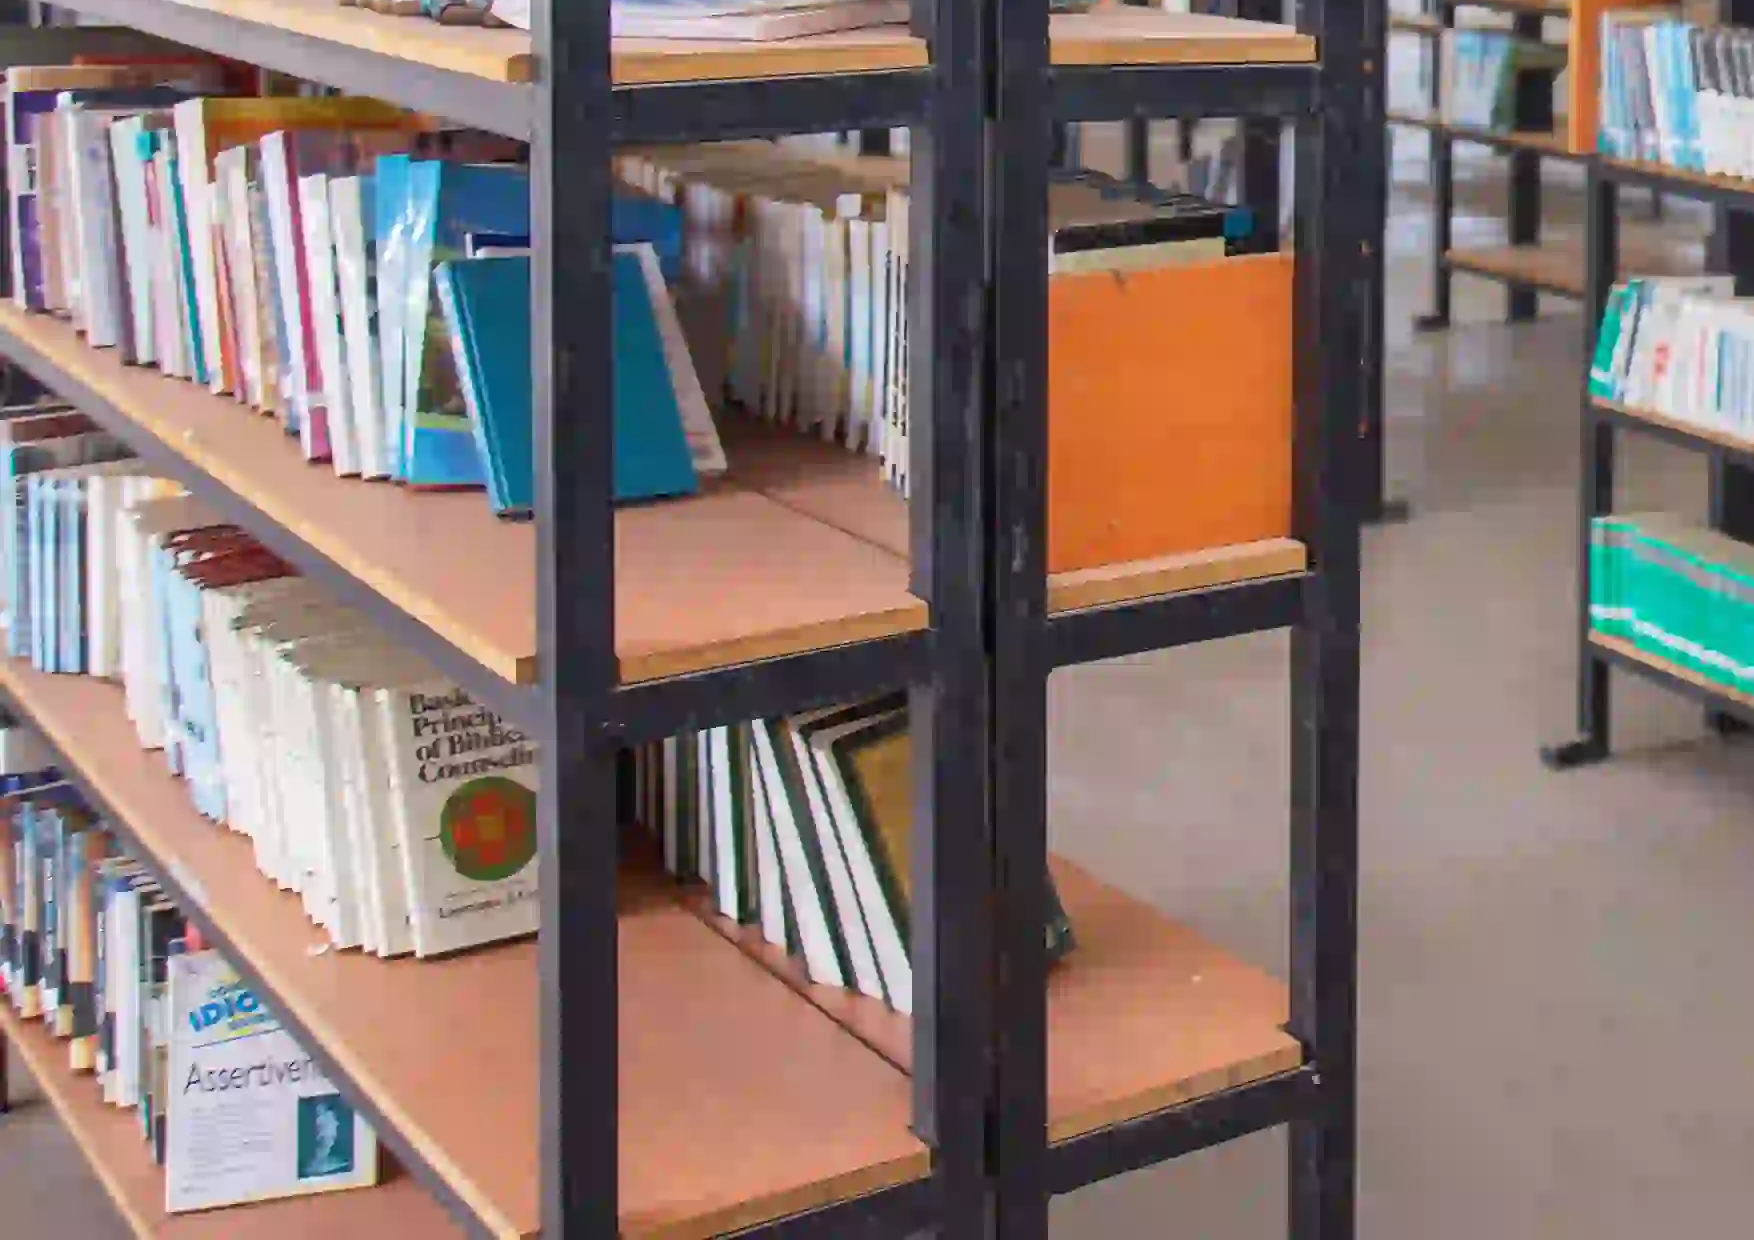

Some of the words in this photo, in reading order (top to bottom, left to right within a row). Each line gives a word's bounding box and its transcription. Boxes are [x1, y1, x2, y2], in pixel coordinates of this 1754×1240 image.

[448, 725, 527, 756] Biblica
[418, 747, 534, 783] Counselin
[188, 989, 259, 1032] IDIO
[183, 1056, 320, 1096] Assertiven
